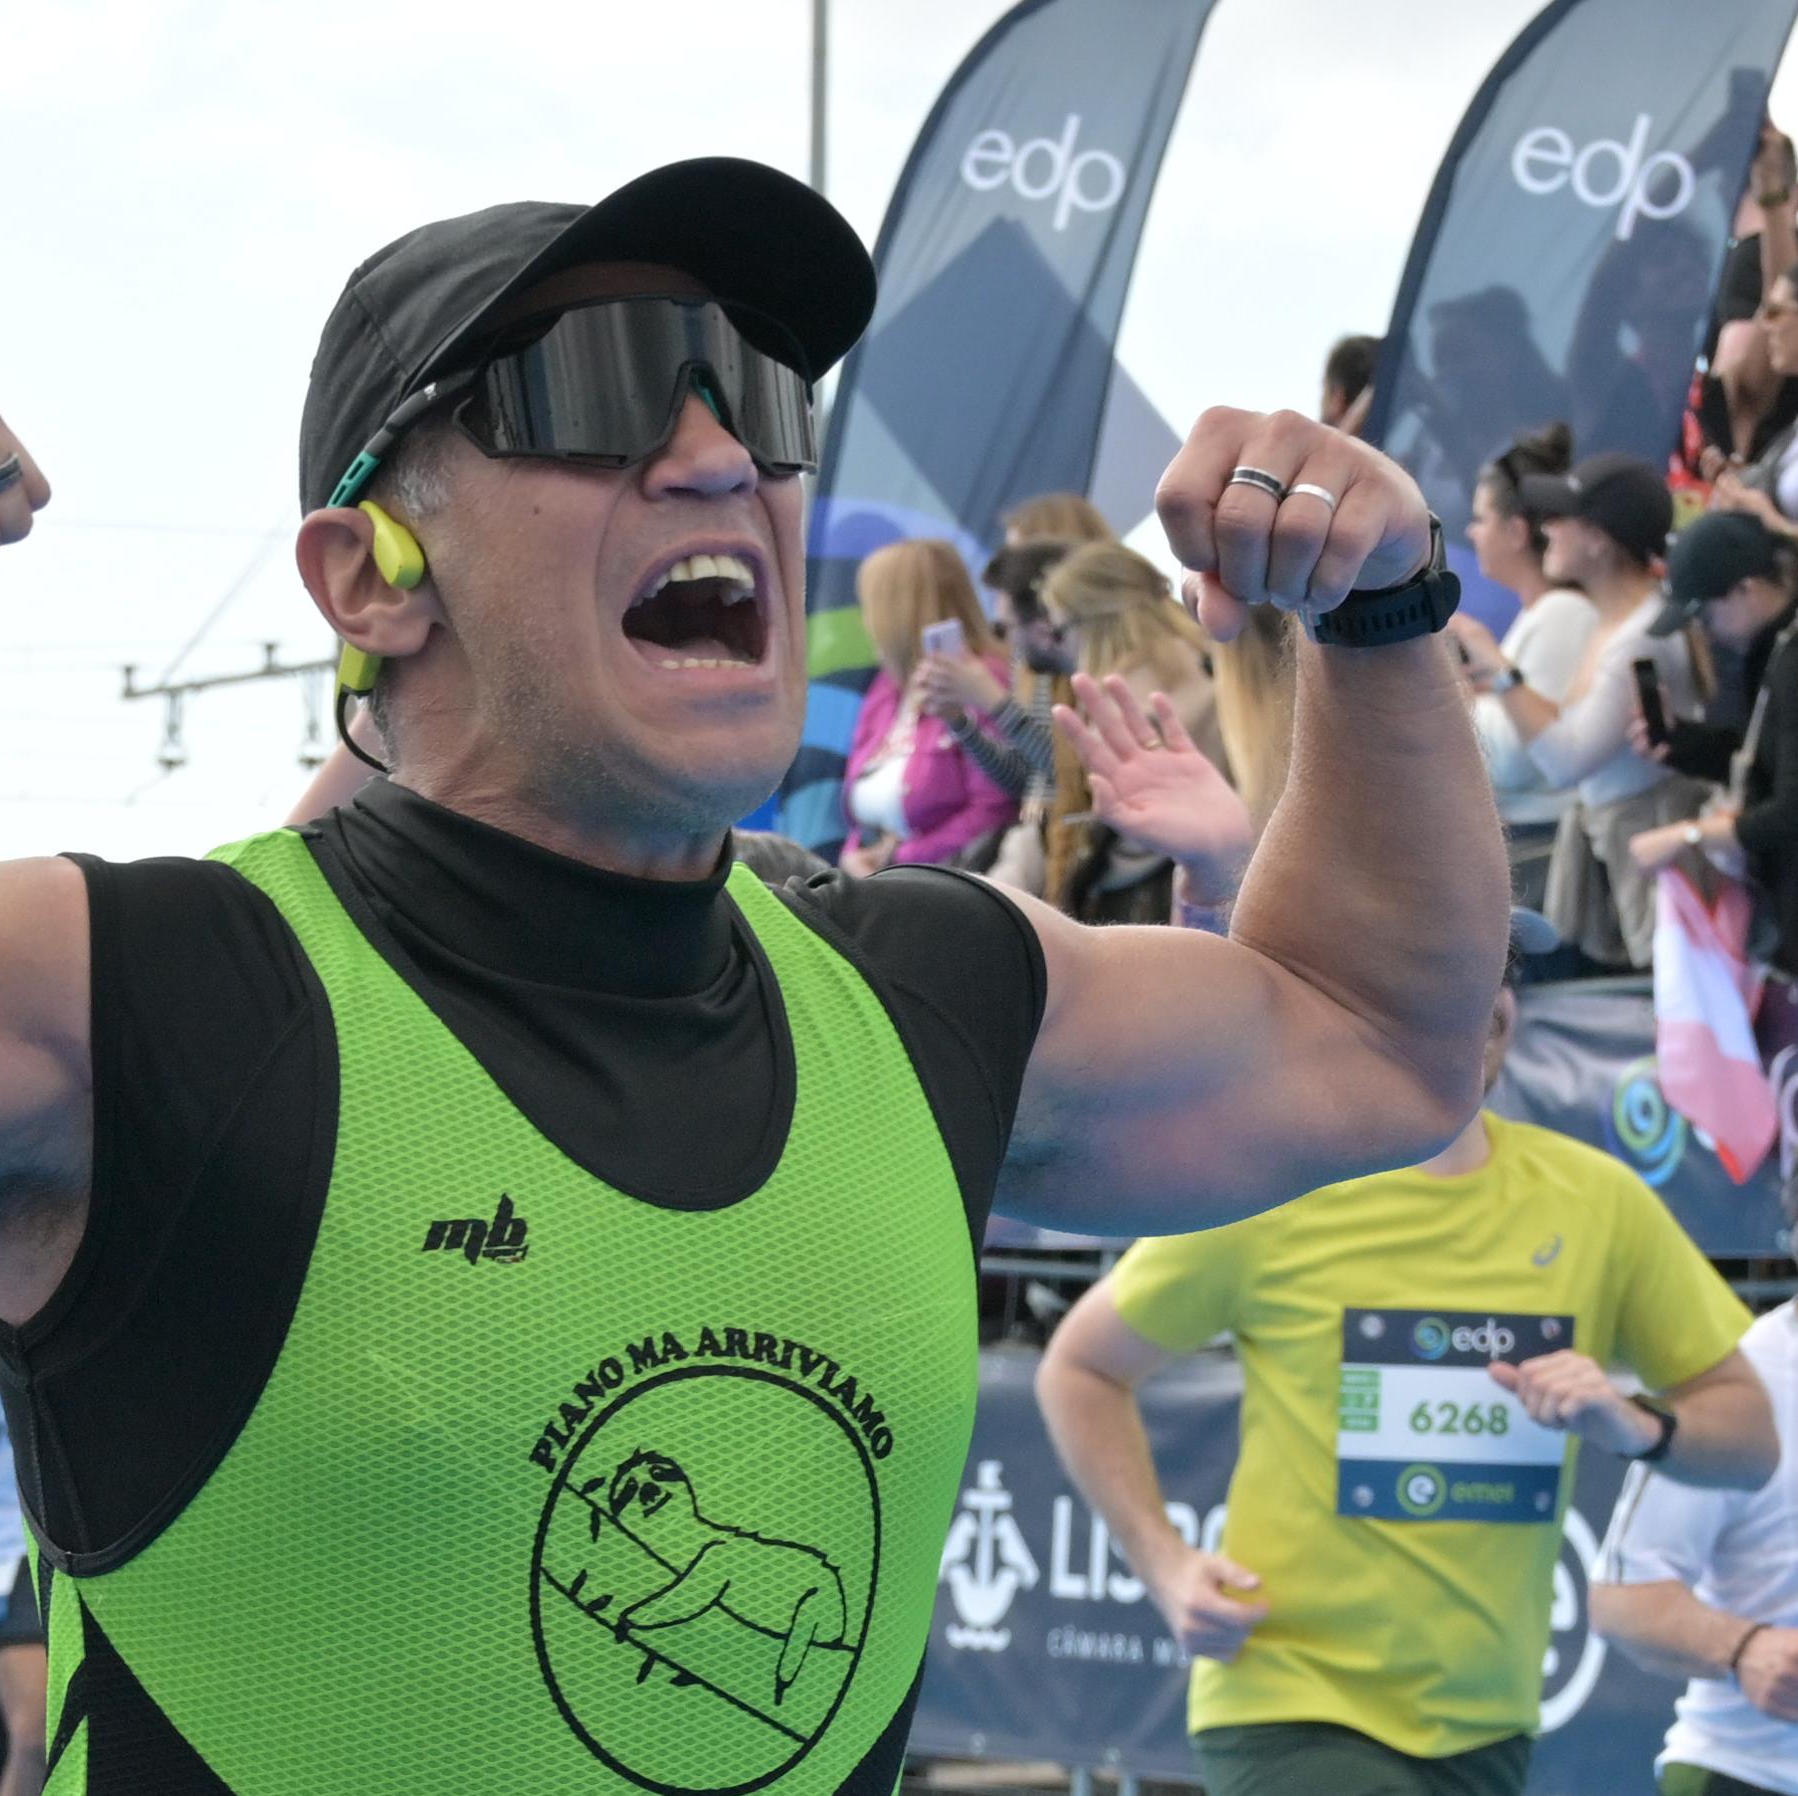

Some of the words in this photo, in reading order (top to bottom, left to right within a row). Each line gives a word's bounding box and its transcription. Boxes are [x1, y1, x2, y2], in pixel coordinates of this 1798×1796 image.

[961, 113, 1126, 231] edp
[1511, 113, 1695, 241] edp
[1451, 1317, 1516, 1361] edp
[528, 1356, 624, 1474] PIANO
[624, 1331, 690, 1375] MA
[693, 1325, 894, 1460] ARRIVIAMO
[1409, 1399, 1510, 1436] 6268
